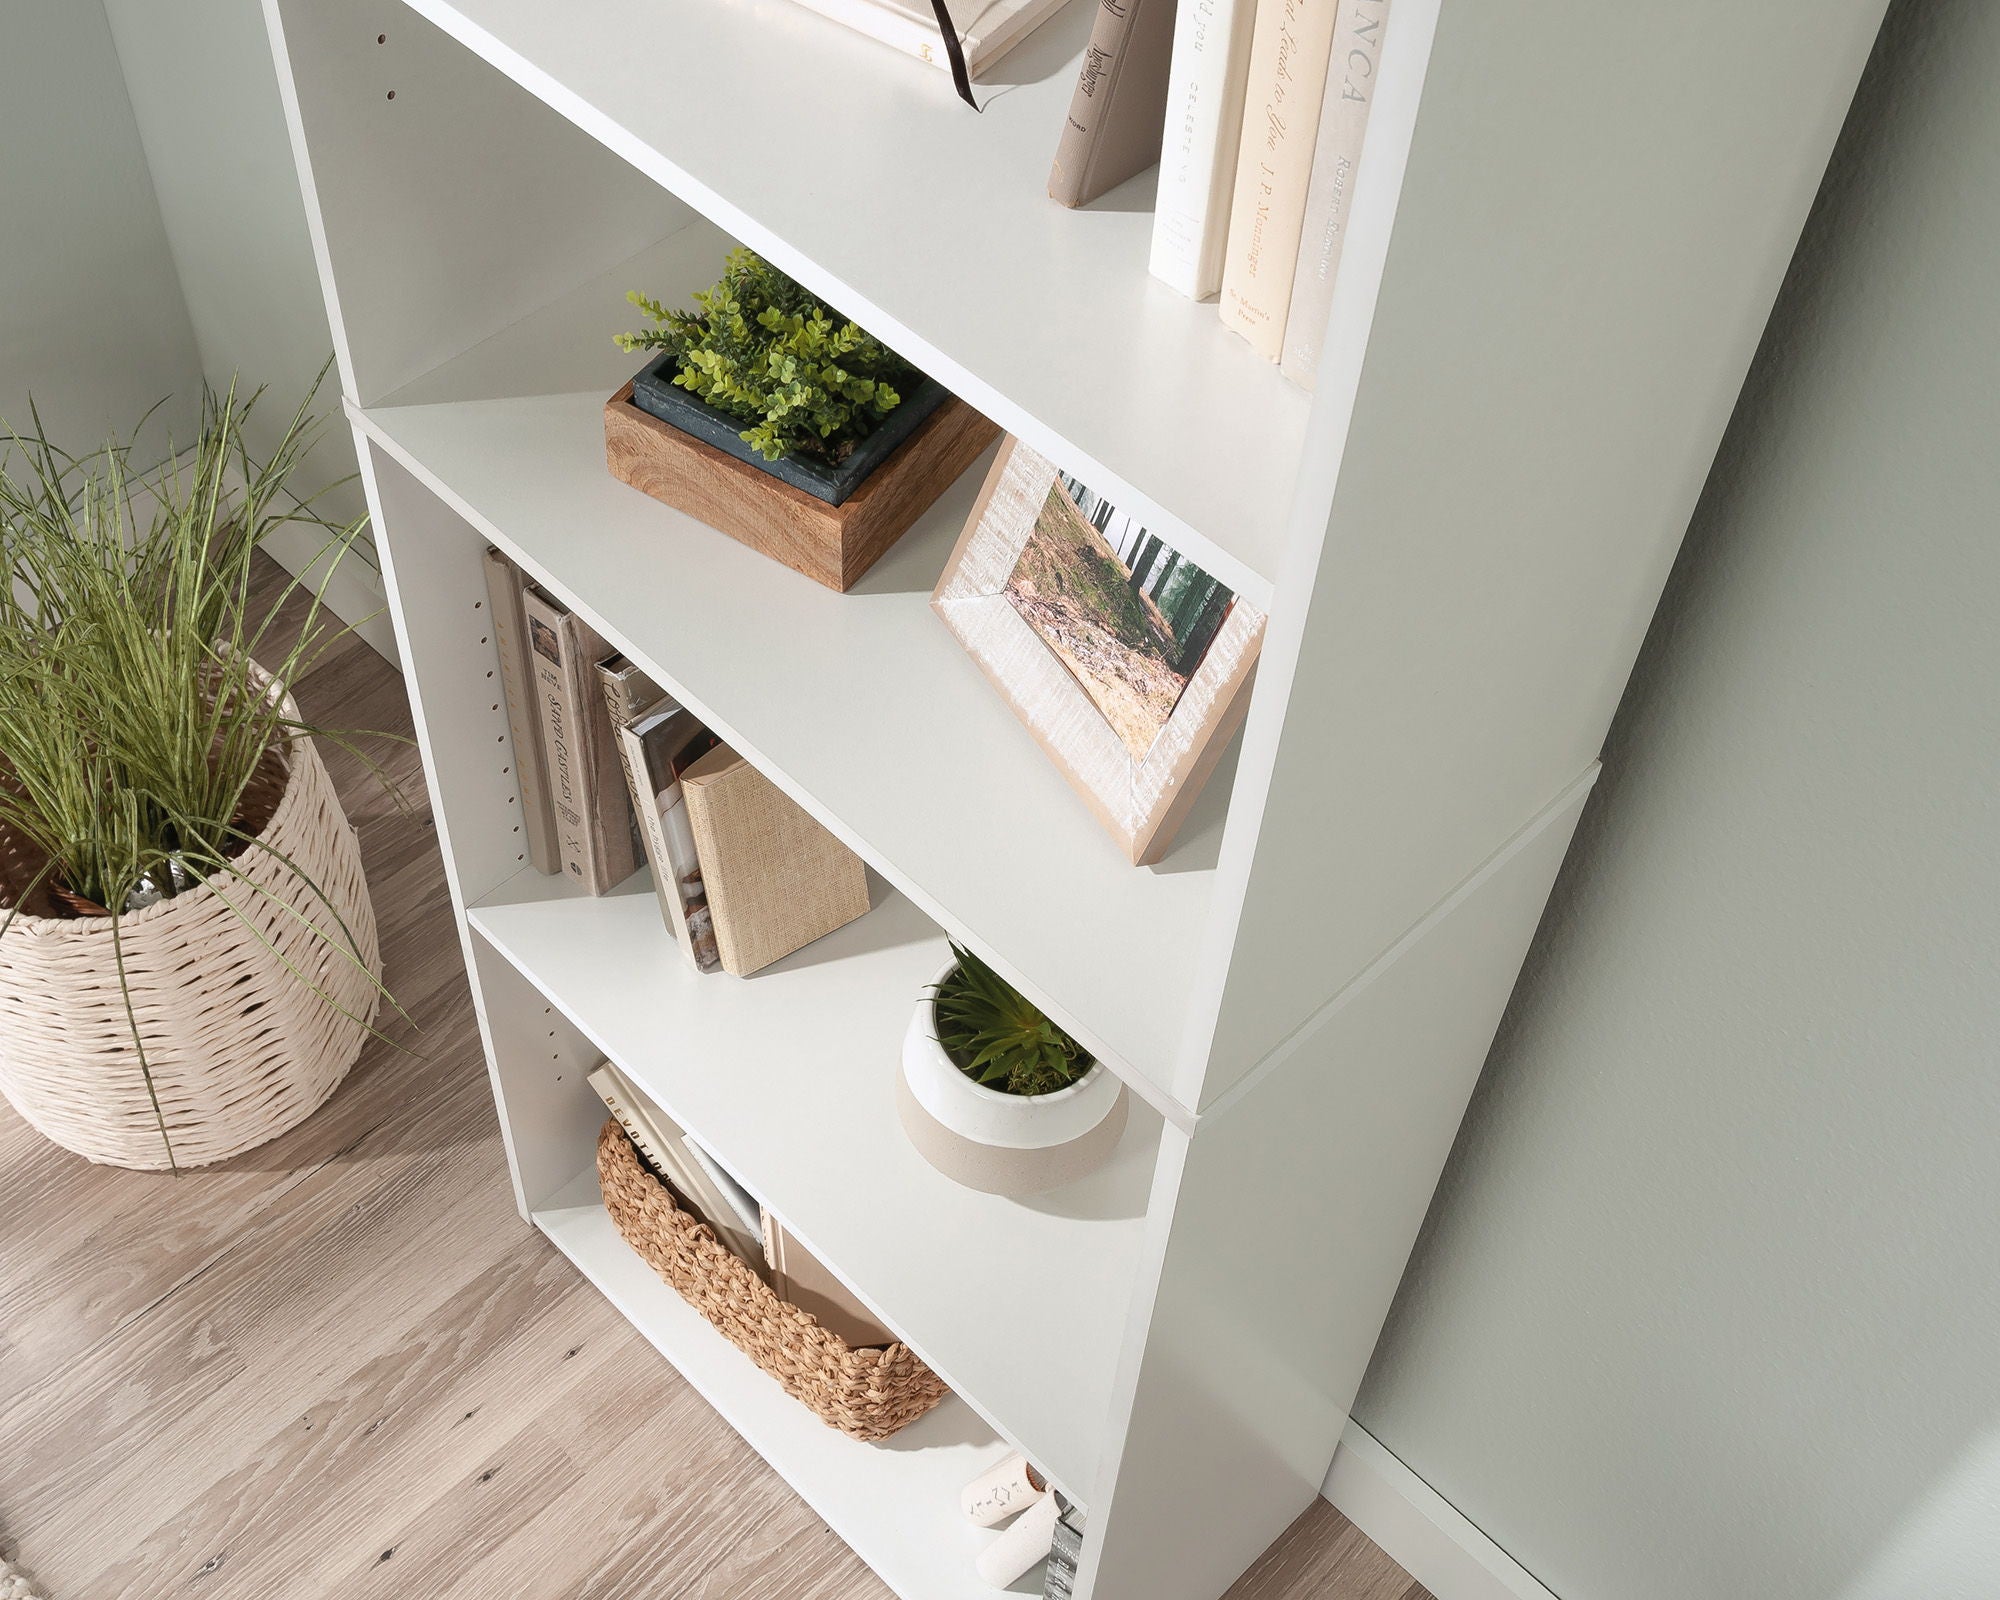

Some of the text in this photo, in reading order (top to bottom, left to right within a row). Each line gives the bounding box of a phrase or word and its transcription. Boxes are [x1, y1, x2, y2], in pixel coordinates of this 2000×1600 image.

[1193, 13, 1207, 53] you
[1342, 0, 1384, 103] NCA
[1275, 82, 1286, 103] to
[1265, 103, 1287, 153] You
[1247, 162, 1274, 279] J. P. Monninger
